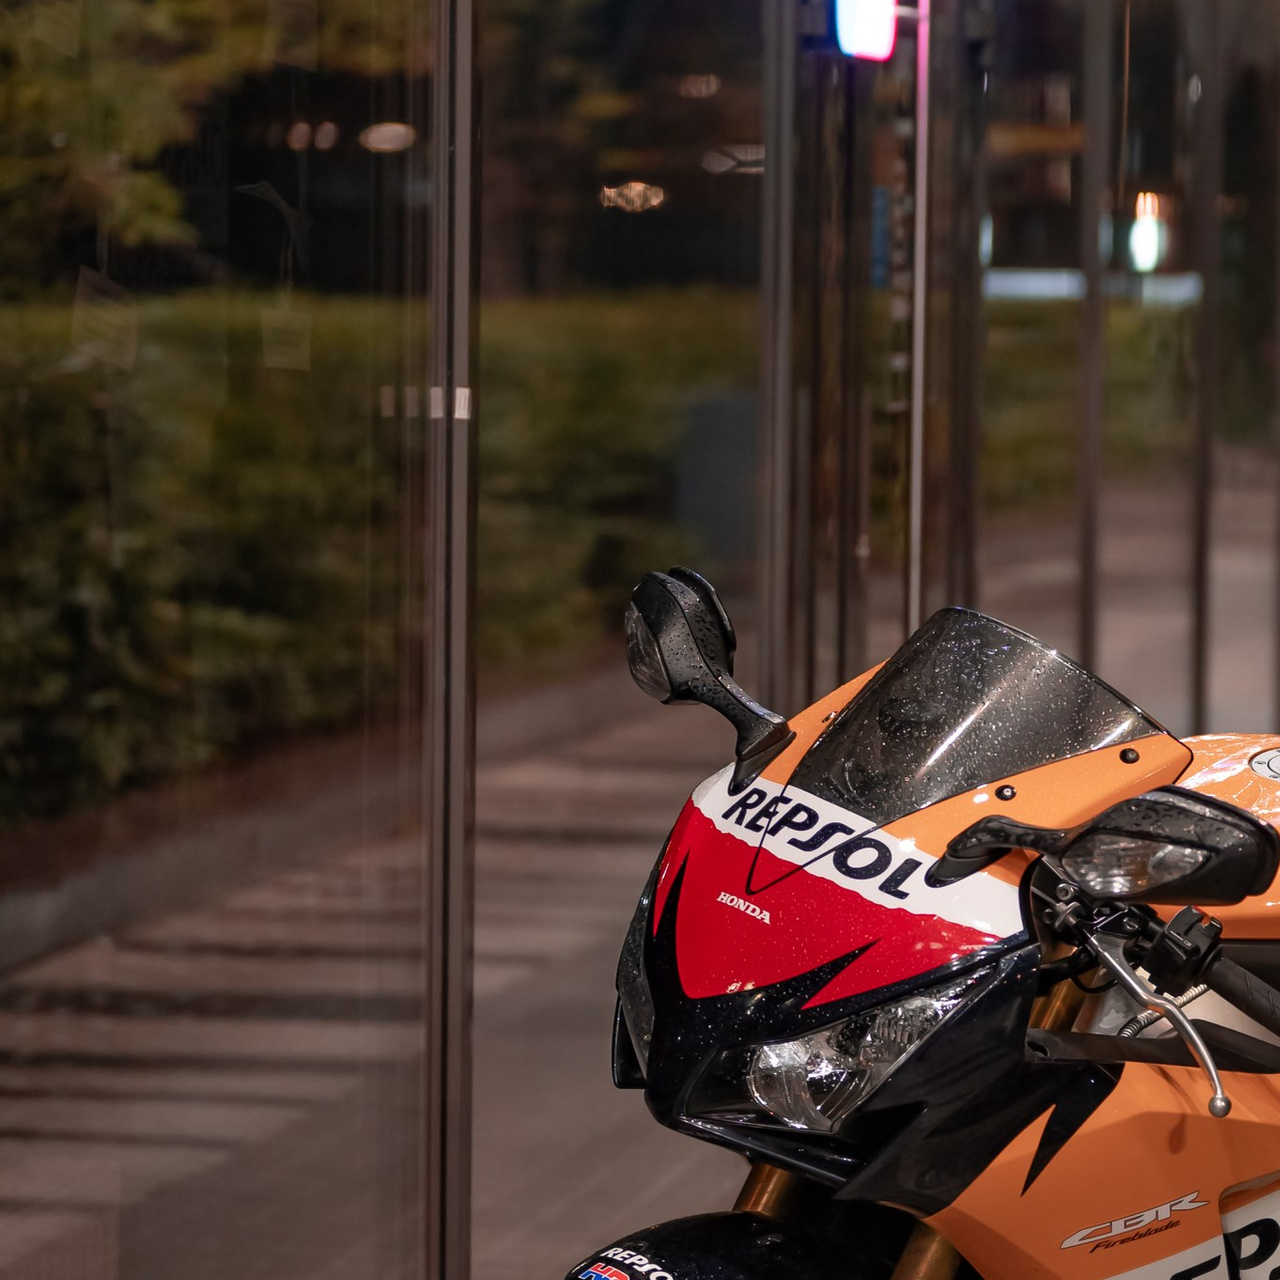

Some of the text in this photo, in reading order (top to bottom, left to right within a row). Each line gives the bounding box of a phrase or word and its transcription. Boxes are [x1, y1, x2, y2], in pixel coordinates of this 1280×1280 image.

[721, 787, 923, 900] REPSOL
[716, 891, 771, 925] HONDA
[1060, 1189, 1211, 1250] CBR
[1089, 1219, 1182, 1254] Fireblade
